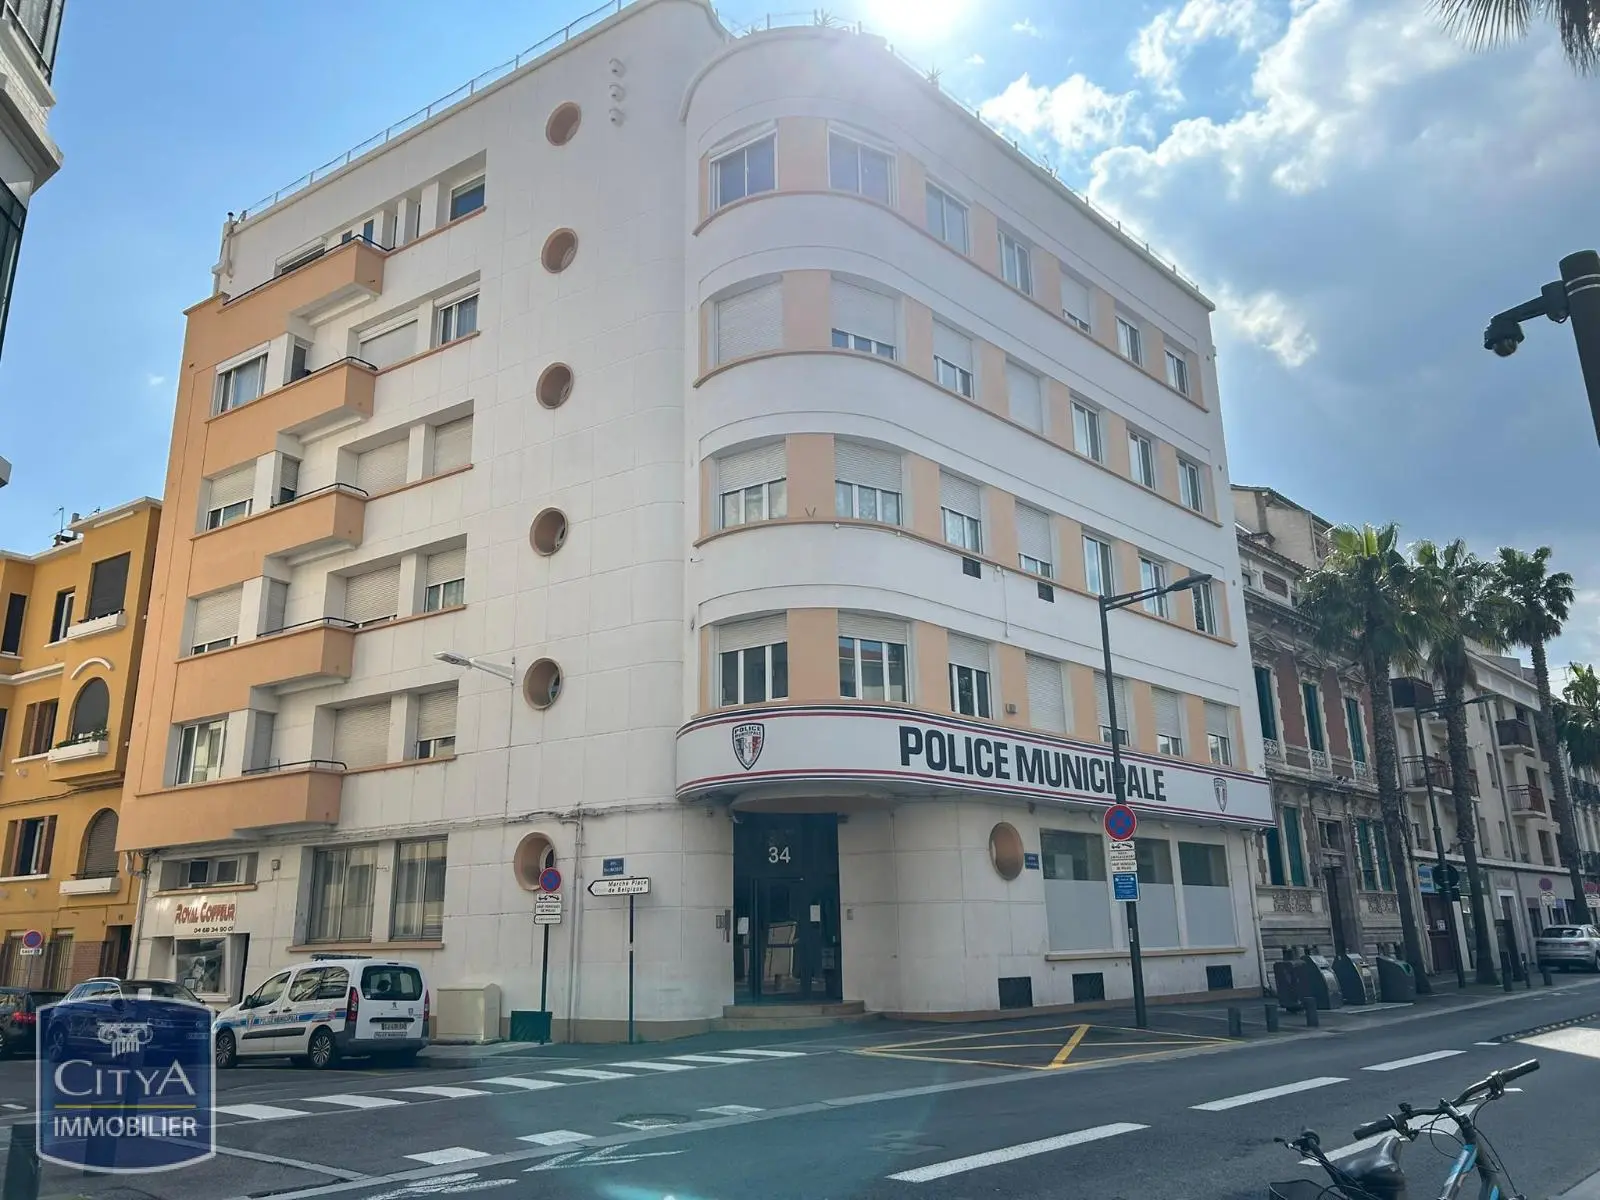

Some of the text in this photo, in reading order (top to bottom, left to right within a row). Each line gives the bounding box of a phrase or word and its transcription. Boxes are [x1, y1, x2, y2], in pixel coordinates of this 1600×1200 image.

[735, 726, 760, 735] POLICE
[899, 726, 1167, 802] POLICE MUNICIPALE
[768, 847, 791, 863] 34
